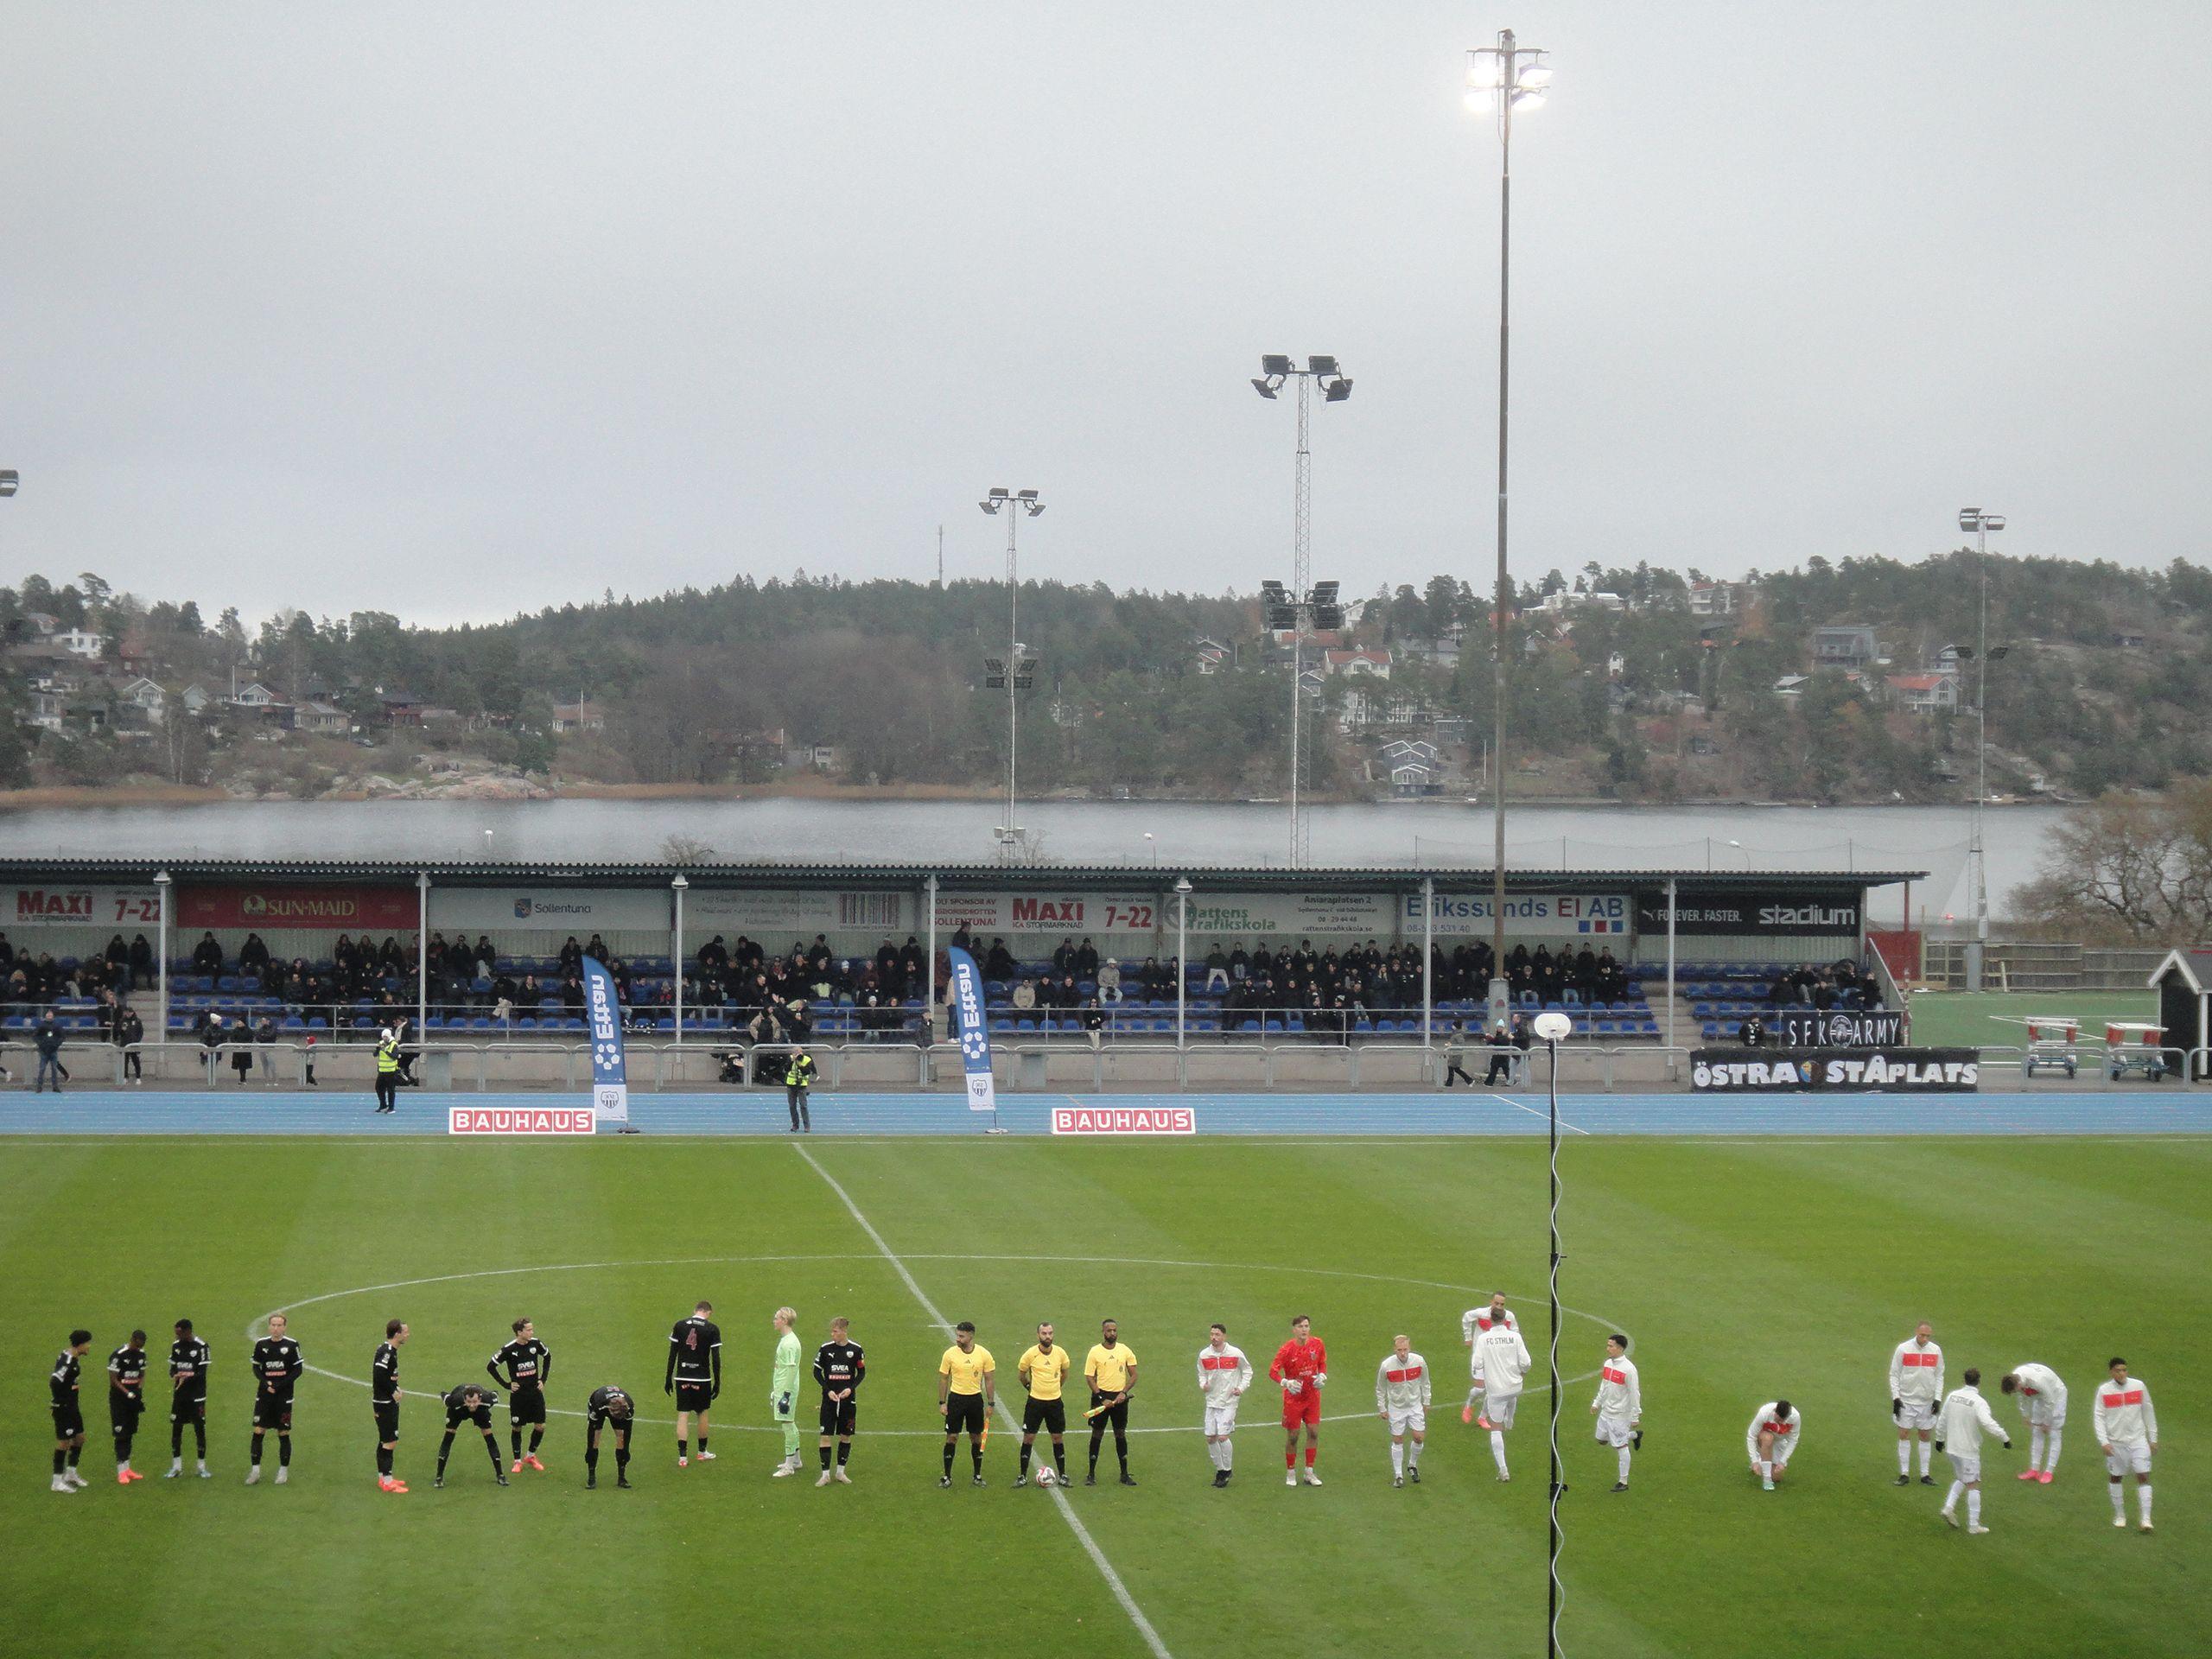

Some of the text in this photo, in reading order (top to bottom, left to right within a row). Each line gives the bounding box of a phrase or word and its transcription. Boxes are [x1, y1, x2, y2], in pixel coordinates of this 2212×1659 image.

[17, 890, 92, 914] MAXI
[267, 899, 354, 916] SUN-MAID
[535, 903, 592, 913] Sollentuna
[1366, 895, 1372, 904] 2
[1407, 897, 1548, 918] Eikssunds
[1588, 897, 1624, 918] AB
[1013, 898, 1084, 921] MAXI
[1657, 910, 1743, 922] FOEVER. FASTER.
[1758, 905, 1855, 925] stadium
[1188, 918, 1275, 931] Trafikskola
[1853, 1018, 1899, 1045] ARMY
[1693, 1054, 1978, 1087] ÖSTRA STÅPLATS
[454, 1111, 591, 1130] BAUHAUS
[1058, 1111, 1189, 1130] BAUHAUS
[685, 1327, 698, 1351] 4
